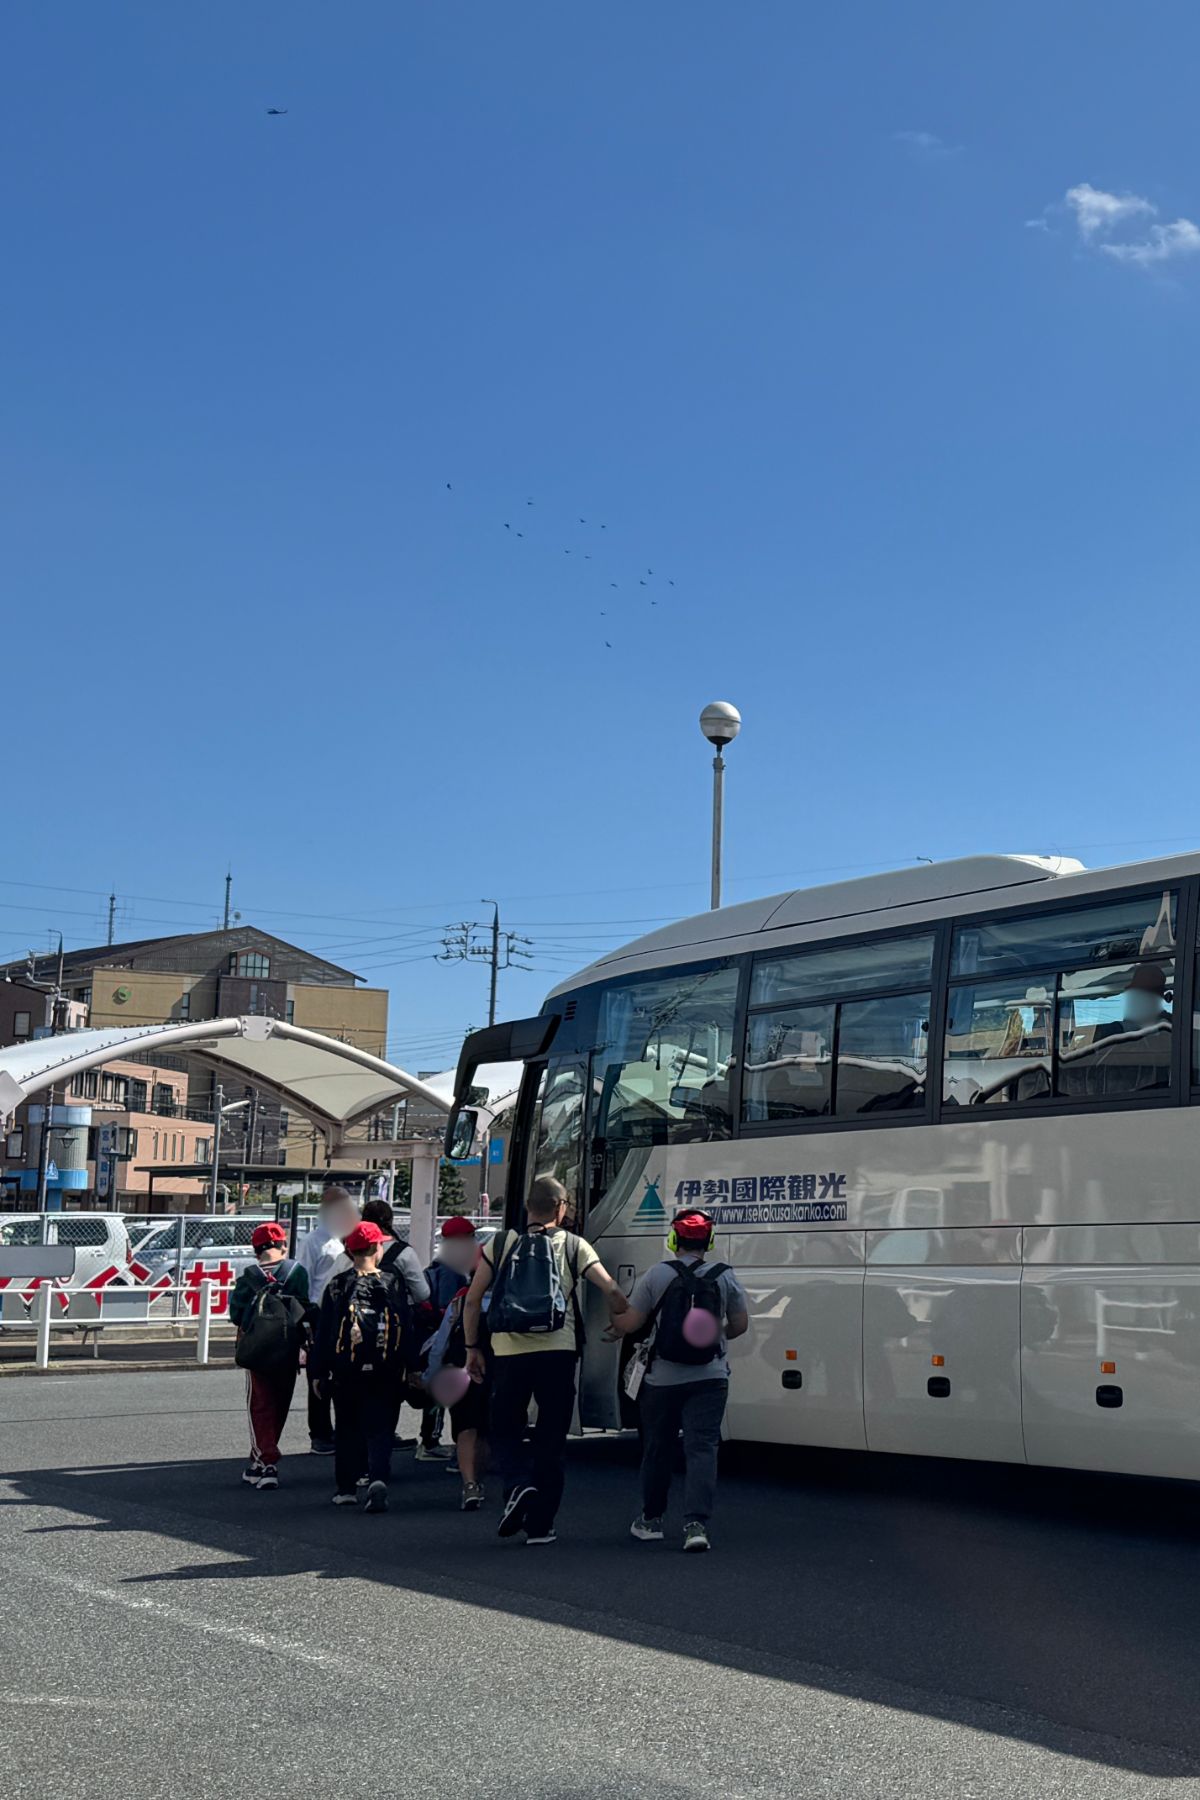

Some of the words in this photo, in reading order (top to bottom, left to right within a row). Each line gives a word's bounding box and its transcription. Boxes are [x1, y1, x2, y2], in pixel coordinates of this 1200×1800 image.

[674, 1172, 847, 1204] 伊勢國際観光
